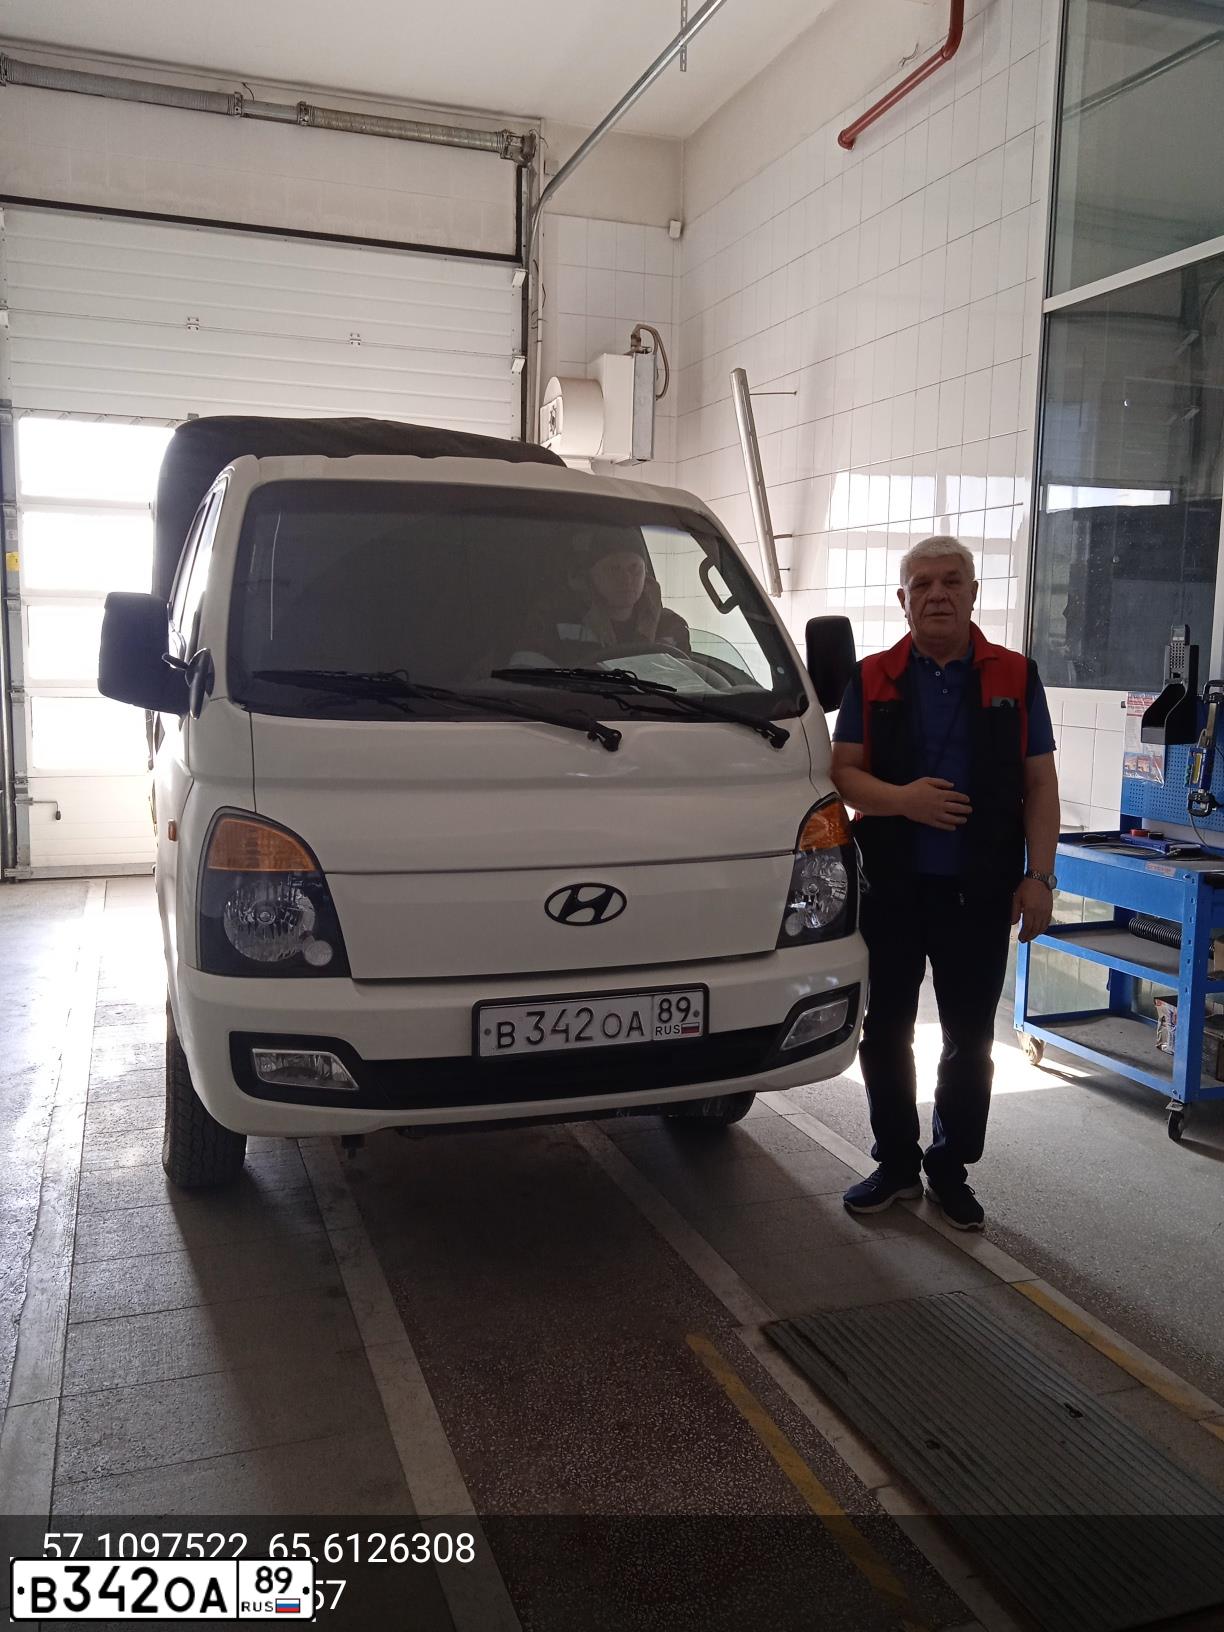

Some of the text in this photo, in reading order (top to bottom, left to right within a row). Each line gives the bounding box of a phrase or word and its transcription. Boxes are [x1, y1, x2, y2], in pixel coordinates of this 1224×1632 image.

[658, 996, 692, 1024] 89
[496, 1006, 645, 1049] В342ОА
[655, 1024, 681, 1036] RUS
